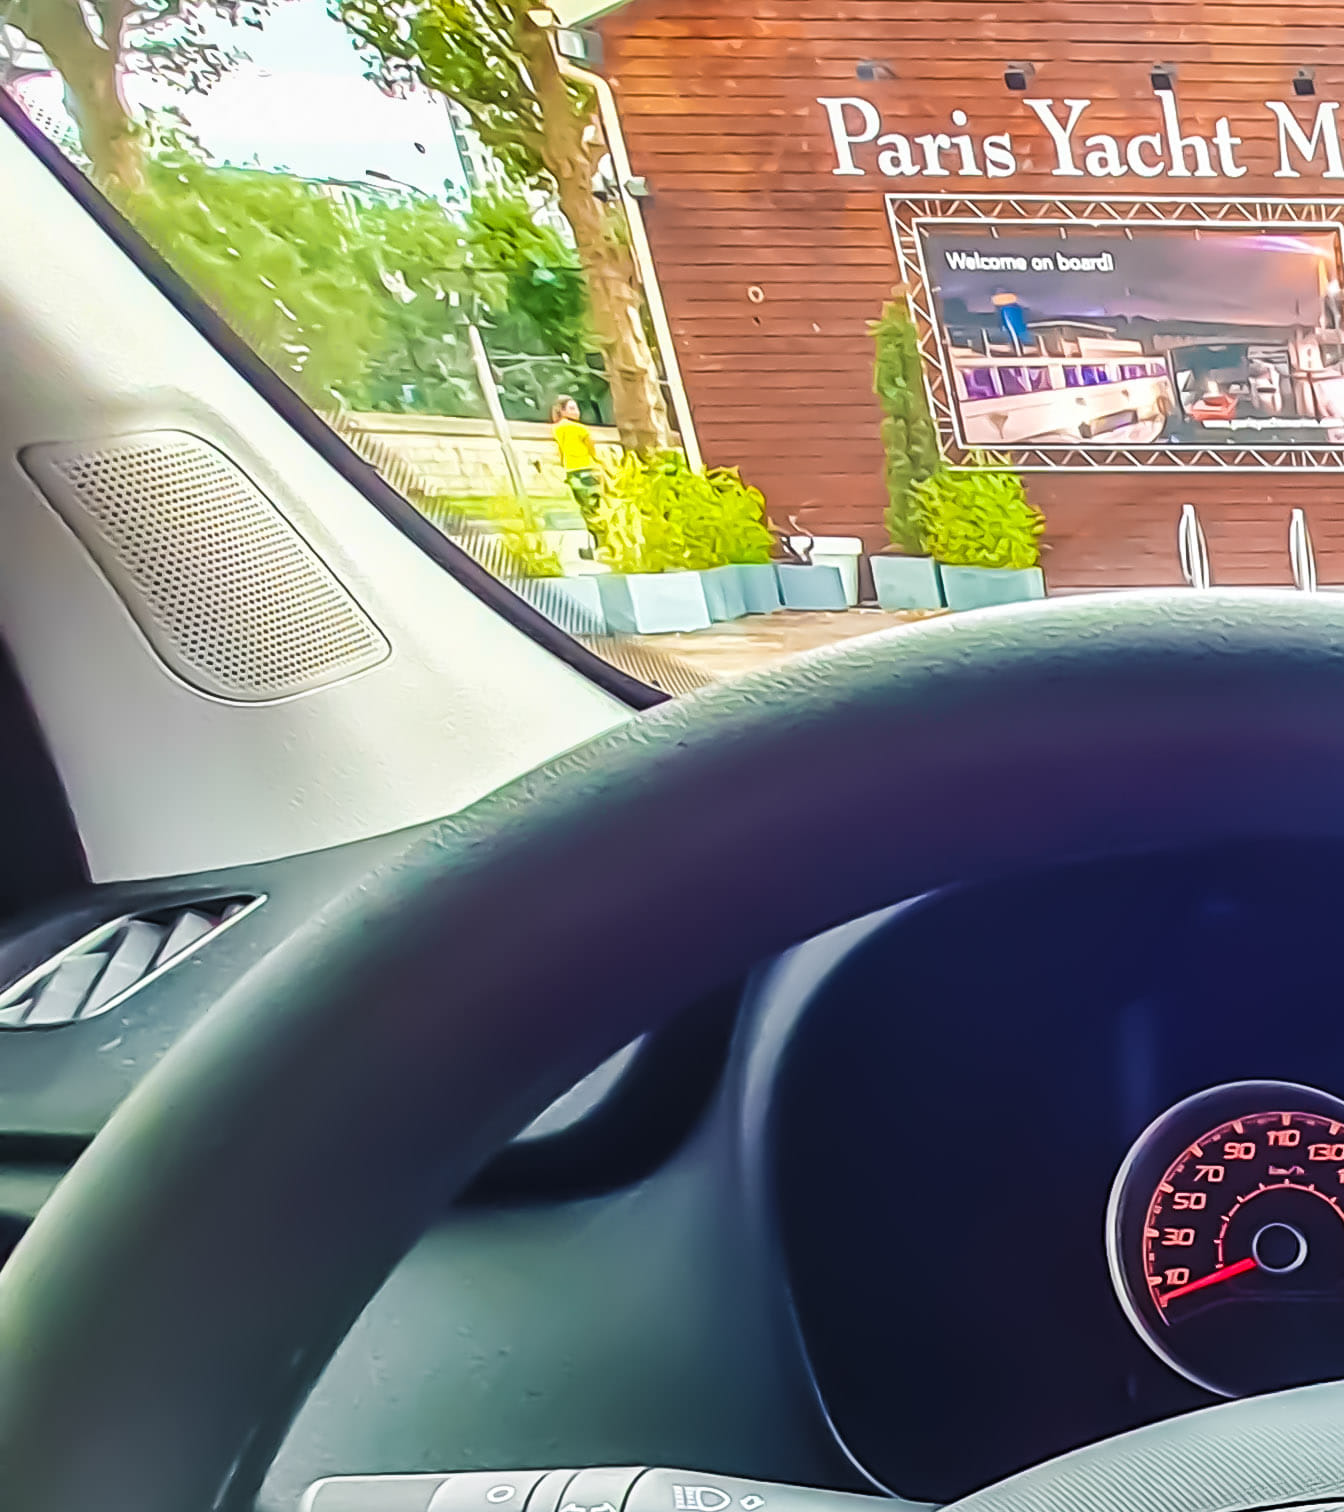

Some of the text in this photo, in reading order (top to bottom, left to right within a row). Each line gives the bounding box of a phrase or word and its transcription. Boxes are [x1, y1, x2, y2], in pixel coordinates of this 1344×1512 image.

[816, 97, 1017, 178] Paris
[1022, 88, 1247, 178] Yacht
[945, 251, 1114, 272] Welcome on board!
[1266, 1129, 1300, 1147] 110
[1223, 1142, 1255, 1160] 90
[1193, 1165, 1225, 1183] 70
[1172, 1192, 1207, 1210] 50
[1161, 1228, 1195, 1246] 30
[1165, 1267, 1190, 1285] 10
